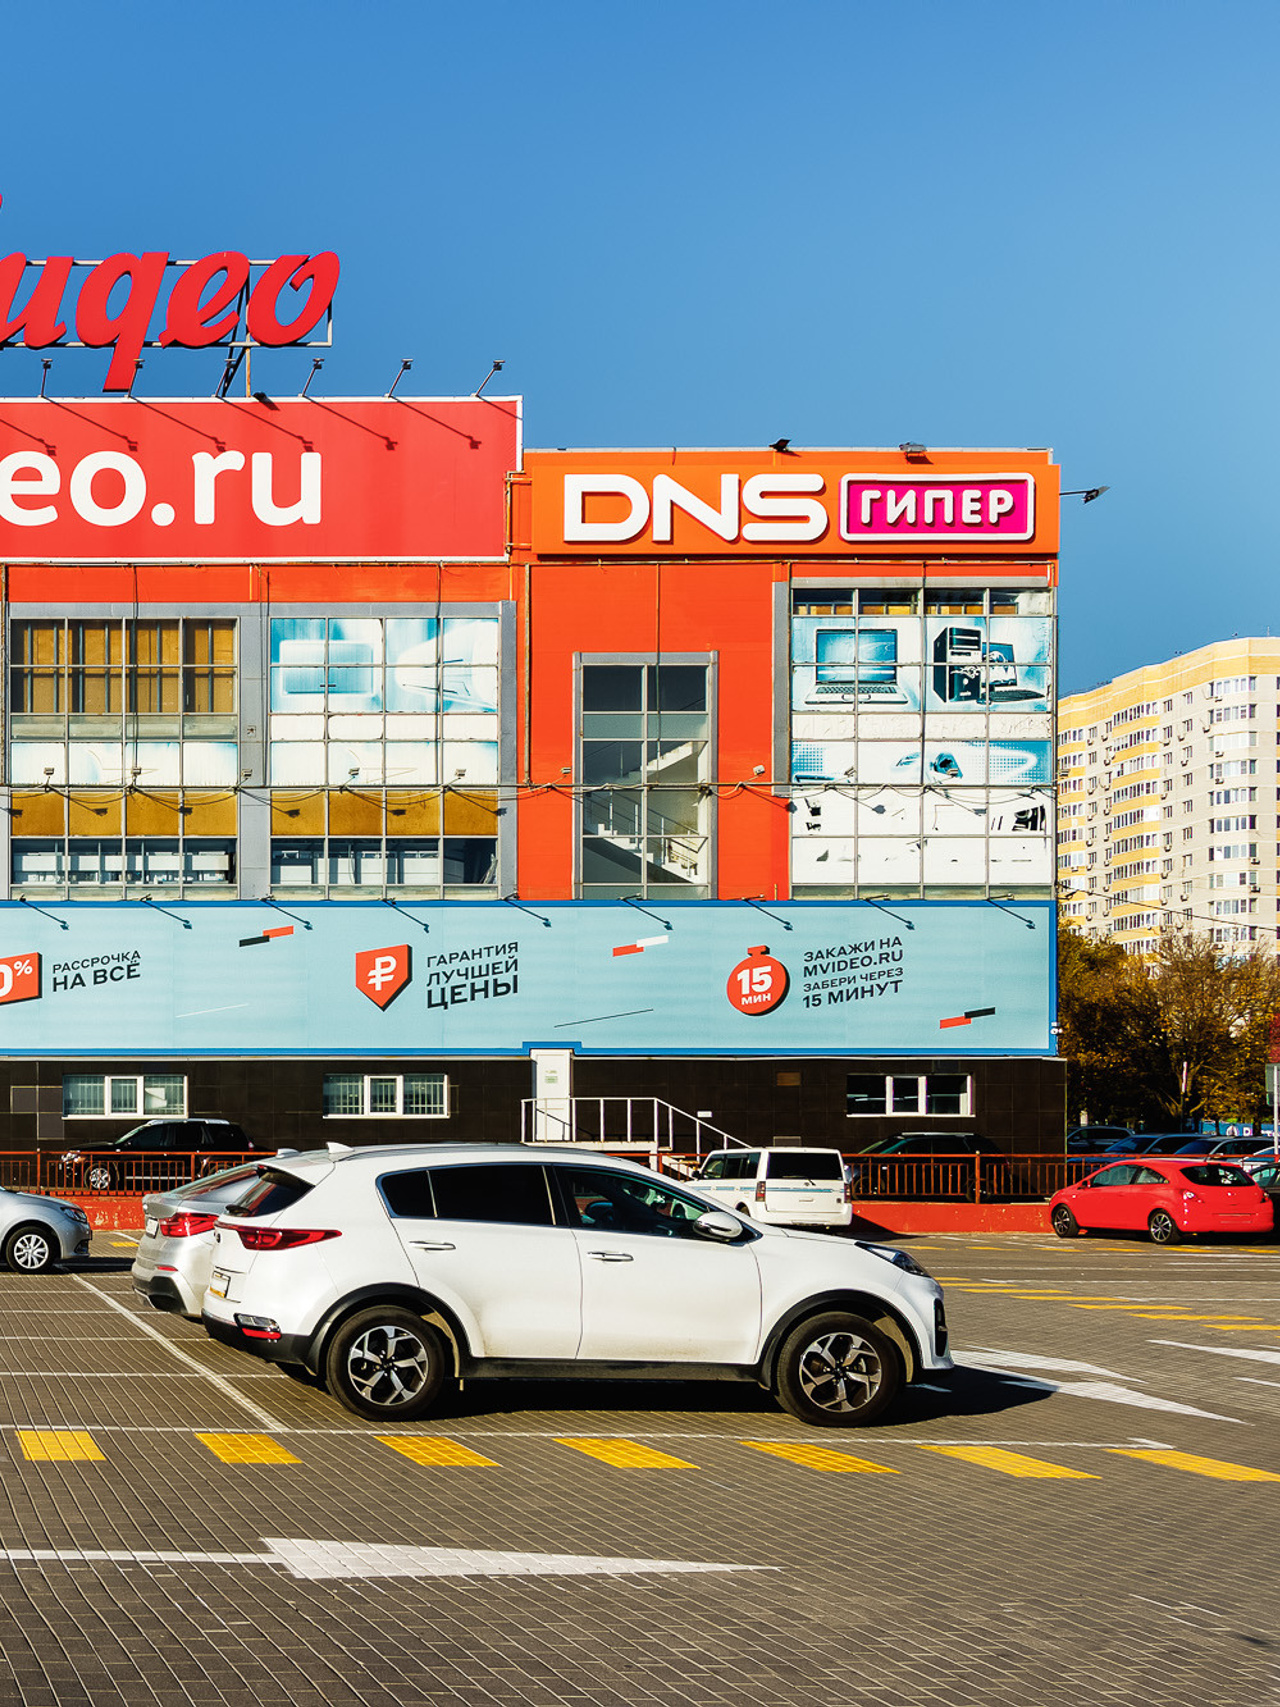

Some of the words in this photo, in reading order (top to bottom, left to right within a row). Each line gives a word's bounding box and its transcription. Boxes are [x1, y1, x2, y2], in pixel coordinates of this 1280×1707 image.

[563, 473, 829, 542] DNS
[860, 489, 1015, 525] ГИПЕР
[52, 950, 142, 974] РАССРОЧКА
[426, 941, 519, 969] ГАРАНТИЯ
[802, 940, 876, 964] ЗАКАЖИ
[879, 936, 904, 950] НА
[802, 949, 904, 979] MVIDEO.RU
[52, 973, 87, 993] НА
[92, 959, 142, 986] ВСЁ
[426, 955, 519, 988] ЛУЧШЕЙ
[736, 965, 773, 996] 15
[802, 975, 857, 993] ЗАБЕРИ
[859, 967, 905, 983] ЧЕРЕЗ
[426, 974, 519, 1011] ЦЕНЫ
[740, 993, 772, 1006] МИН
[802, 993, 823, 1010] 15
[827, 979, 904, 1006] МИНУТ
